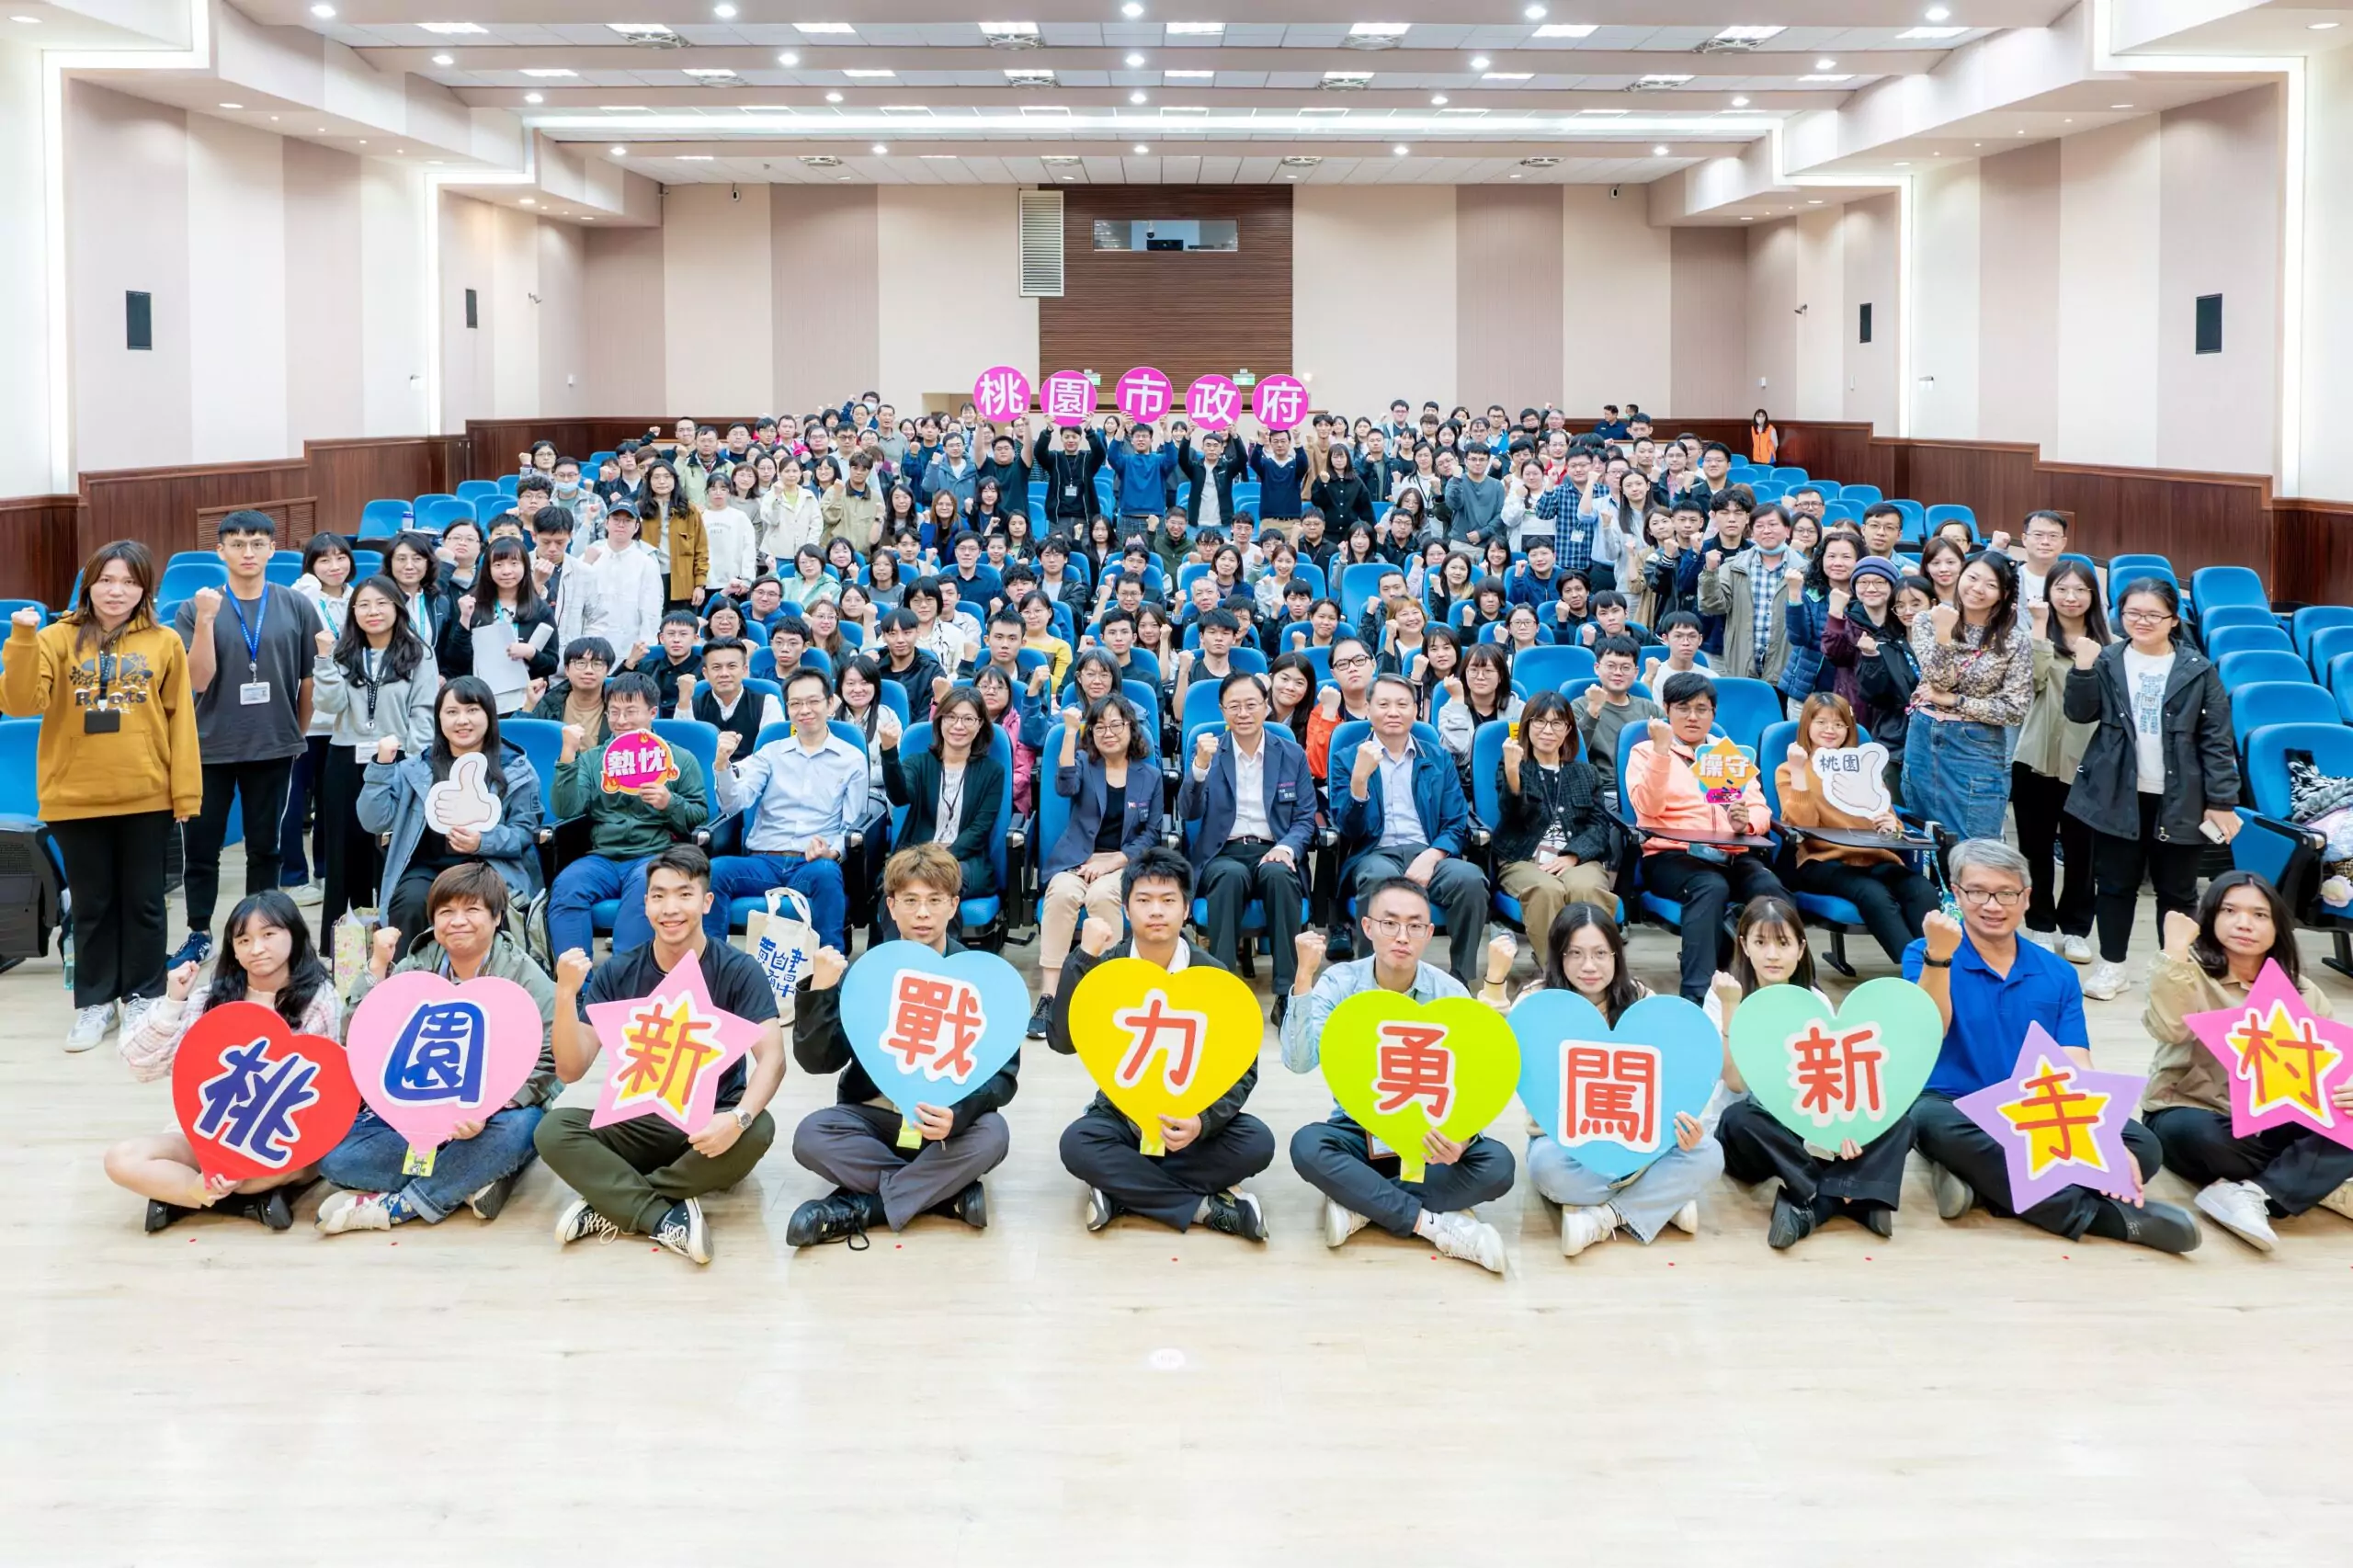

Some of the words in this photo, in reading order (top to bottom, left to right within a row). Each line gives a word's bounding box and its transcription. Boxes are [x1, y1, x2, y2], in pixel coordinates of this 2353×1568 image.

[980, 372, 1024, 416] 桃
[1049, 378, 1090, 418] 園
[1124, 374, 1166, 415] 市
[1192, 382, 1237, 424] 政
[1260, 381, 1303, 423] 府
[608, 746, 668, 778] 熱忱
[1699, 753, 1751, 778] 操守
[1819, 754, 1860, 773] 桃園
[383, 1002, 487, 1105] 園
[620, 1004, 710, 1105] 新
[889, 977, 980, 1074] 戰
[1123, 999, 1196, 1085] 力
[2237, 1013, 2325, 1108] 村
[199, 1040, 317, 1161] 桃
[1378, 1026, 1449, 1118] 勇
[1566, 1048, 1654, 1143] 闖
[1795, 1027, 1881, 1114] 新
[2016, 1072, 2099, 1159] 手
